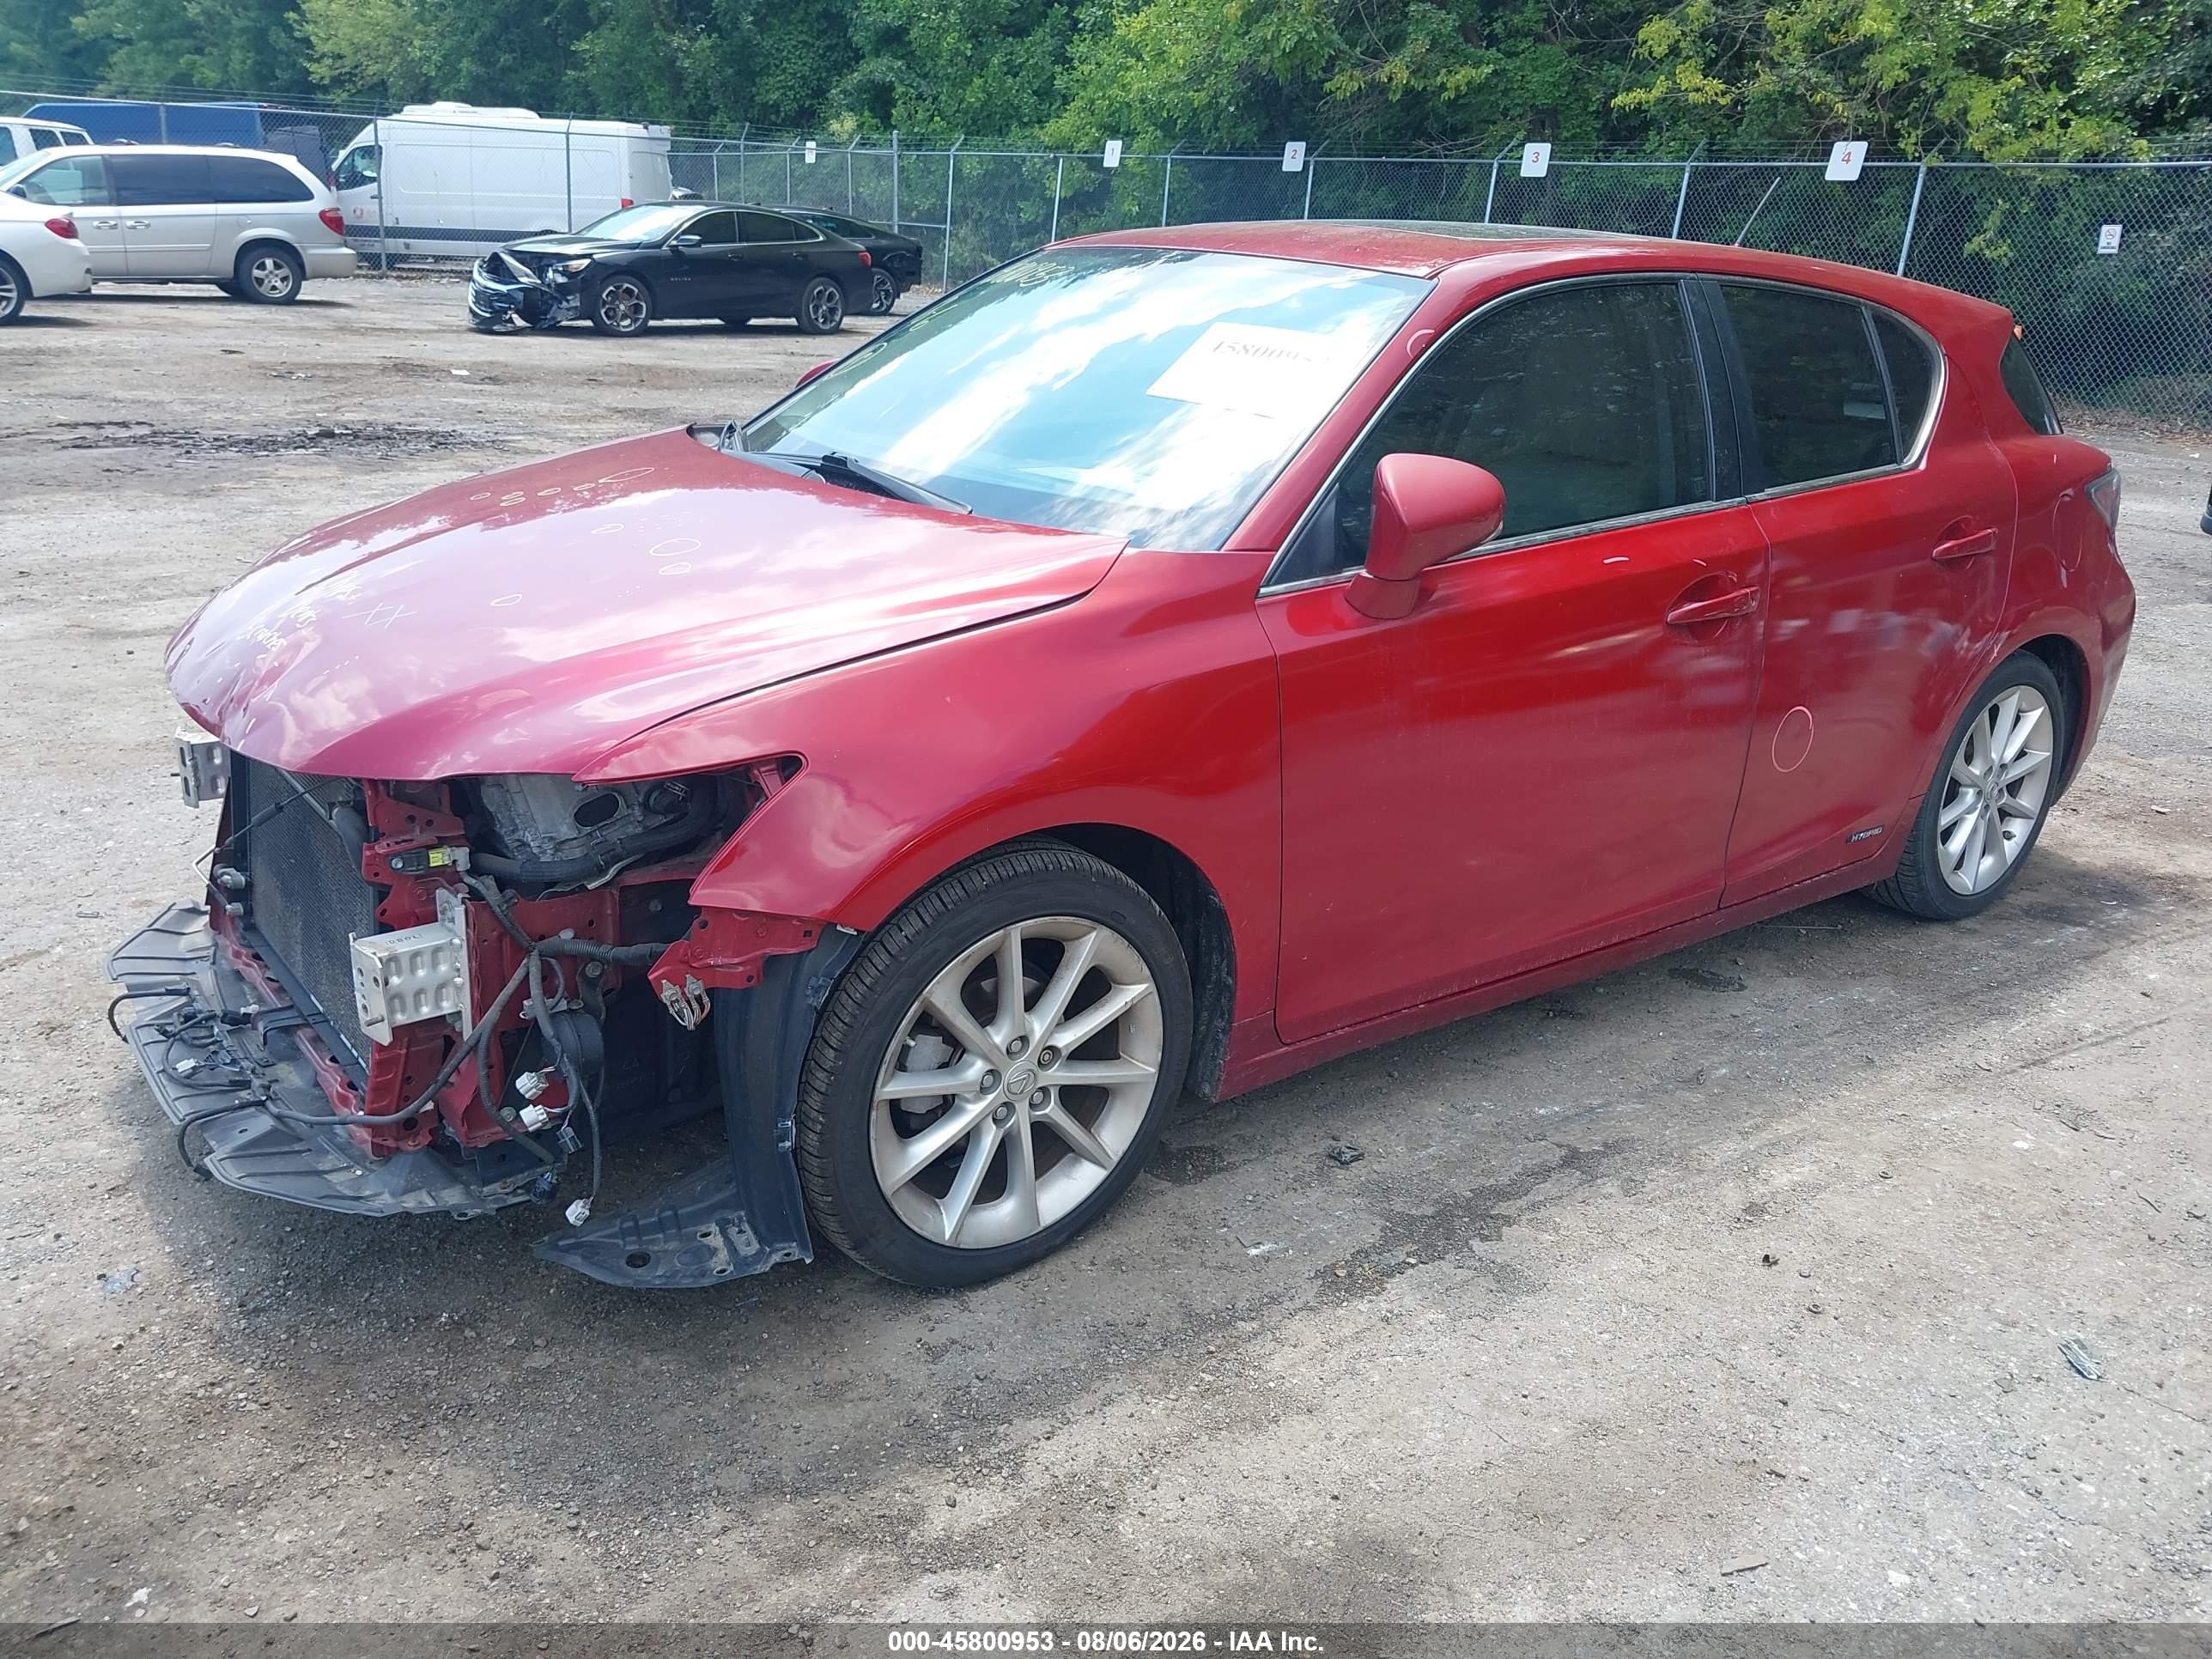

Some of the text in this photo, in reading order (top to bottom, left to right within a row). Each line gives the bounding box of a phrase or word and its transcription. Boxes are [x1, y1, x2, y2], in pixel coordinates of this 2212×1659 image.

[1291, 149, 1298, 160] 2
[1531, 151, 1540, 163] 3
[1841, 151, 1852, 164] 4
[1850, 827, 1883, 843] HYBRID
